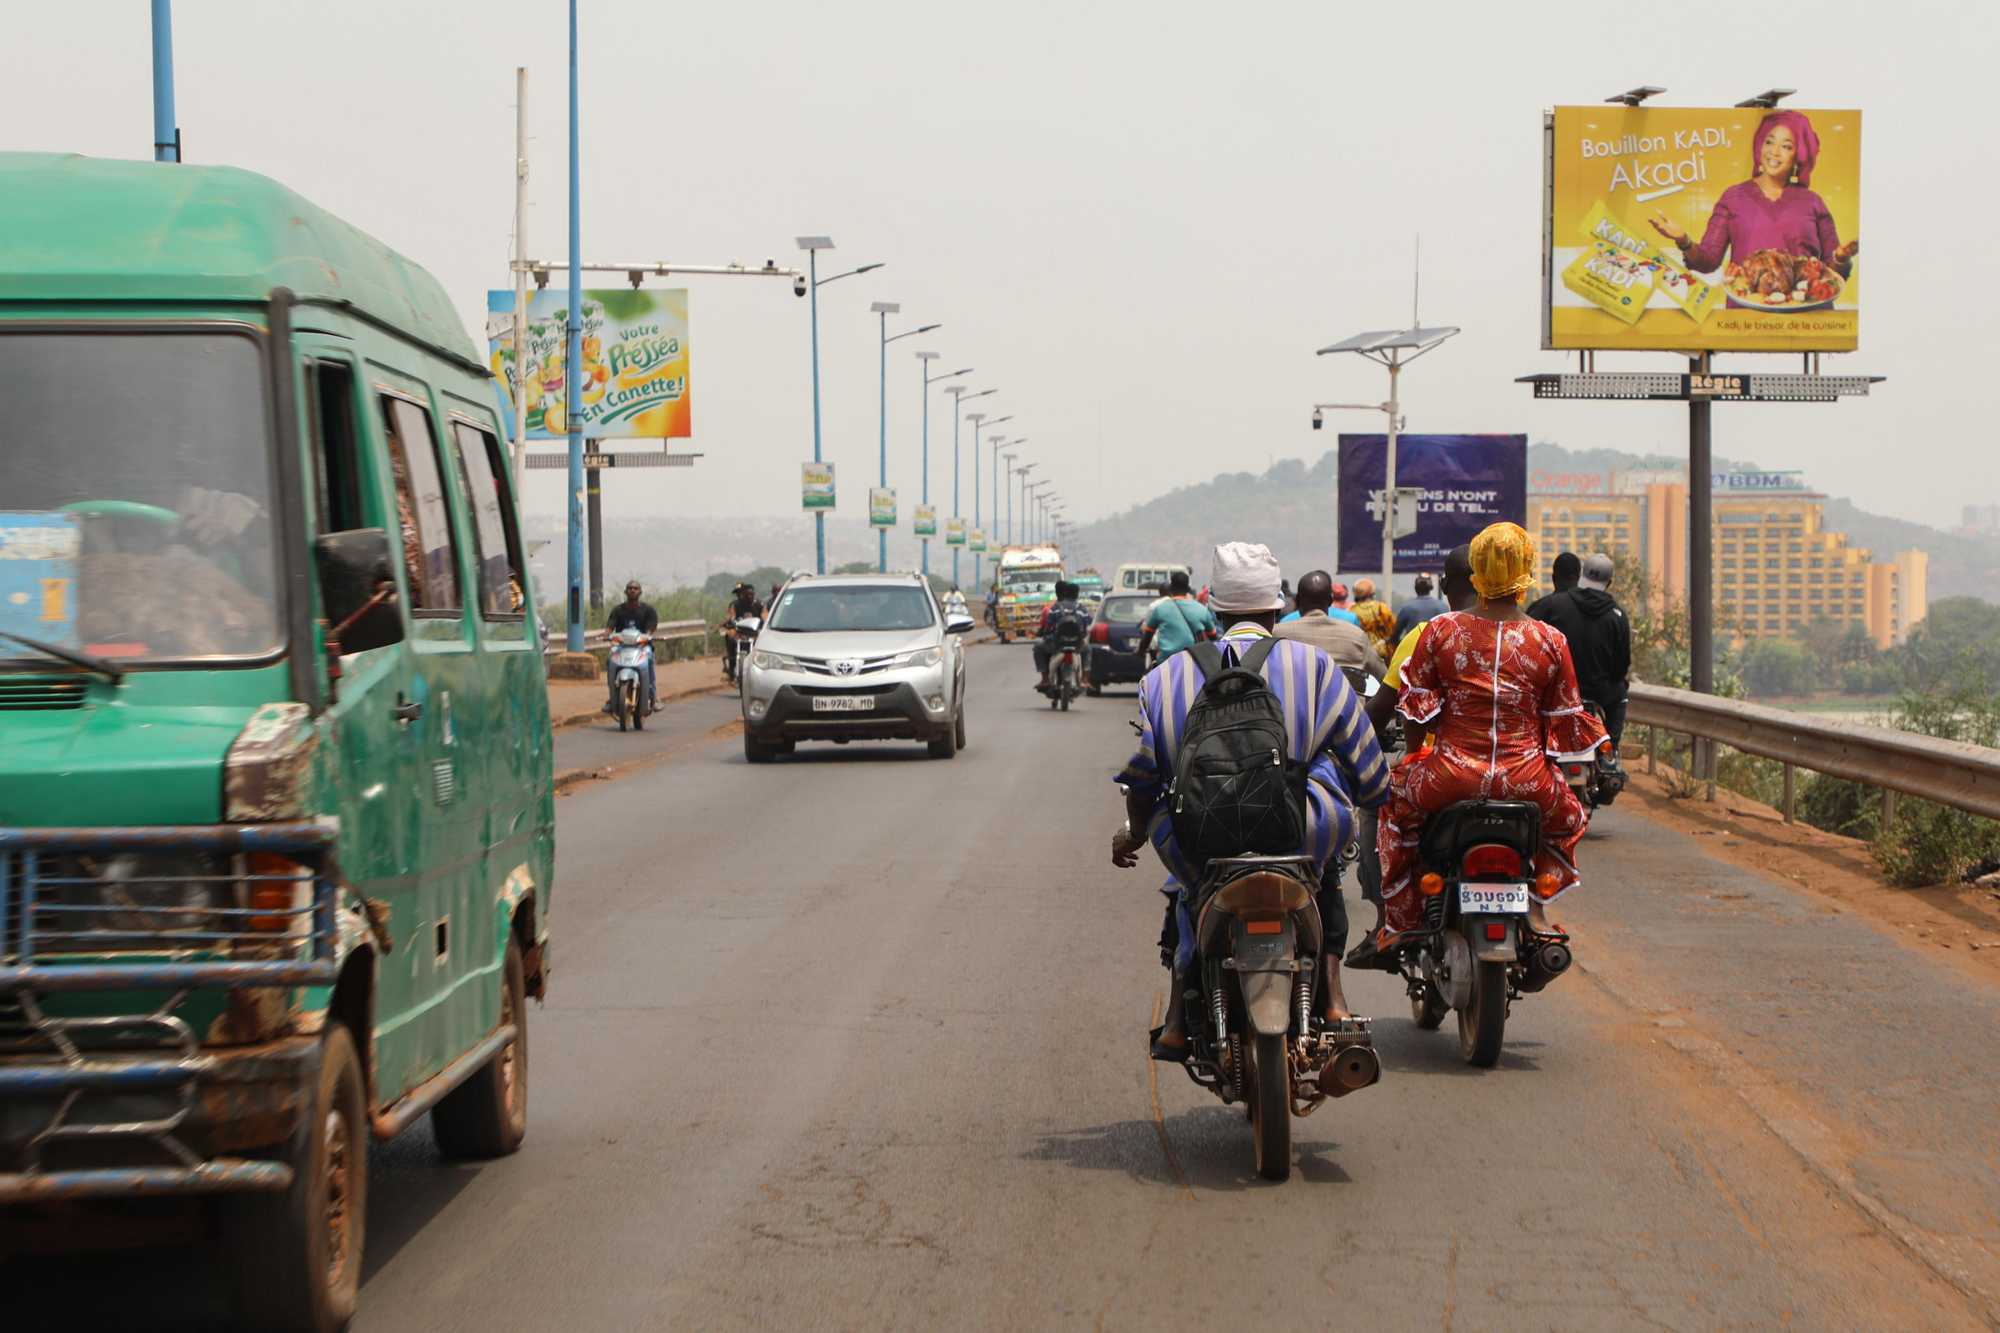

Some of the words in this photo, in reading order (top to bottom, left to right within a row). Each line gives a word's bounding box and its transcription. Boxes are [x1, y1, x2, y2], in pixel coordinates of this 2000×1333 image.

[1581, 135, 1667, 159] Bouillon
[1673, 127, 1733, 149] KADI,
[1608, 150, 1707, 193] Akadi
[619, 324, 659, 341] Votre
[581, 404, 604, 423] En
[1447, 491, 1497, 502] N'ONT
[1433, 502, 1455, 513] DE
[1458, 503, 1486, 514] TEL
